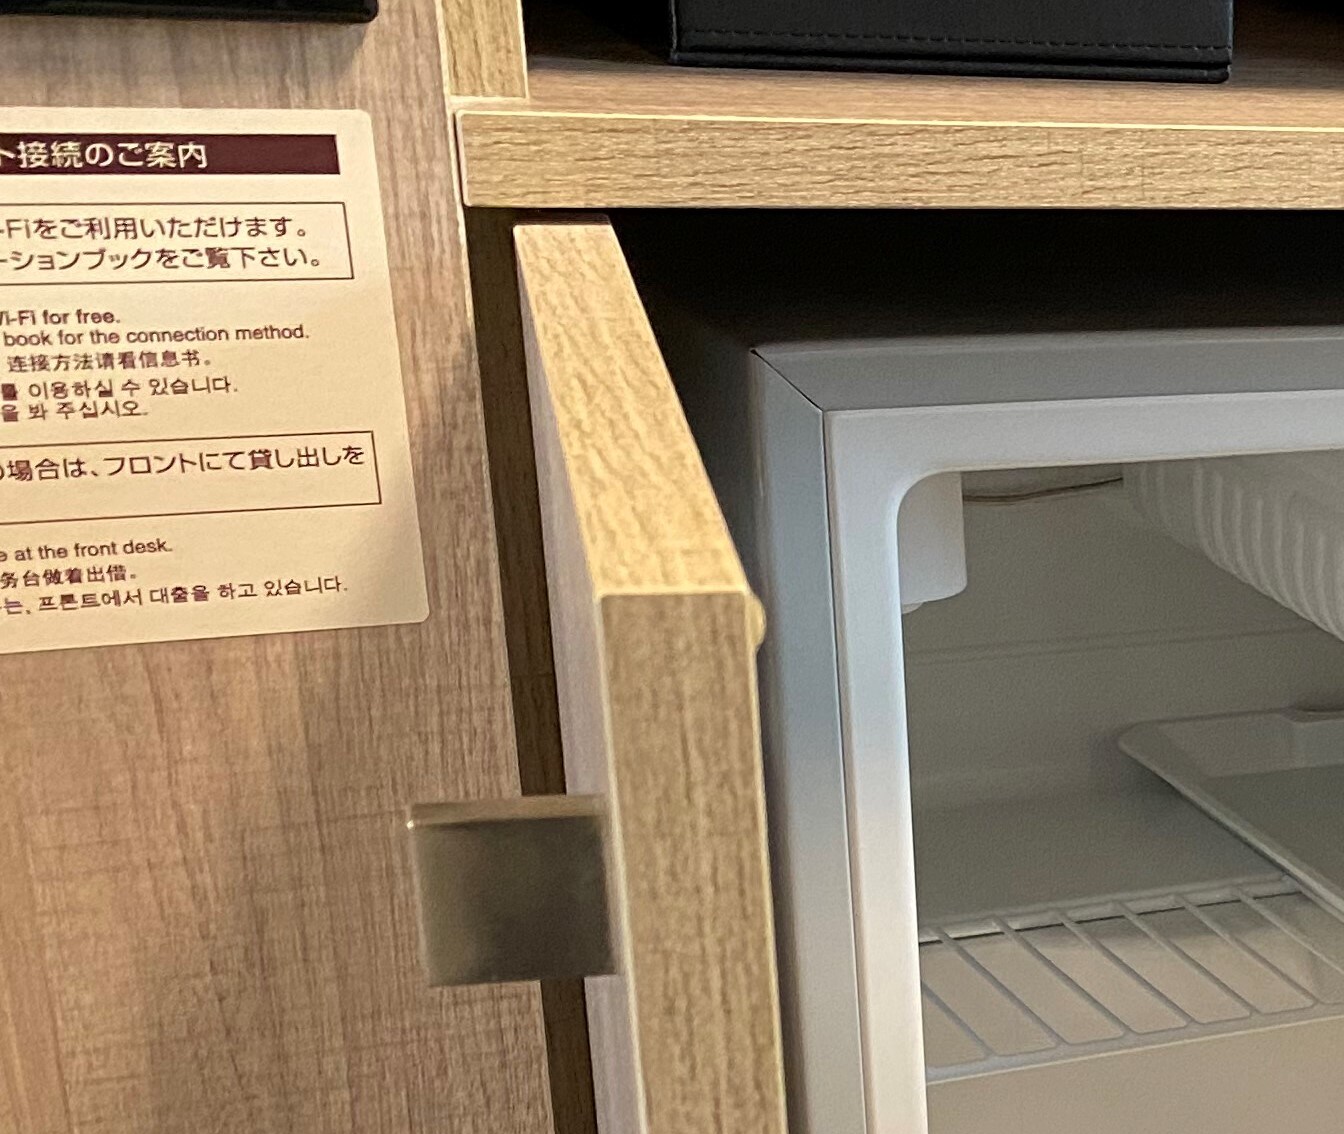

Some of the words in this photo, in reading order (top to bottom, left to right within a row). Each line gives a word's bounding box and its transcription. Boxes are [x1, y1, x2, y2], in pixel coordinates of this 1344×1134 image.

[43, 310, 70, 325] for
[76, 309, 121, 325] free.
[3, 331, 52, 347] book
[58, 330, 84, 345] for
[90, 329, 120, 344] the
[127, 326, 229, 343] connection
[235, 324, 310, 341] method.
[28, 379, 114, 399] 이용하실
[121, 379, 141, 397] 수
[149, 375, 239, 396] 있습니다.
[56, 400, 149, 419] 주십시오.
[15, 546, 33, 561] at
[38, 544, 68, 559] the
[74, 541, 118, 557] front
[122, 538, 174, 554] desk.
[217, 582, 258, 600] 하고
[264, 575, 349, 596] 있습니다.
